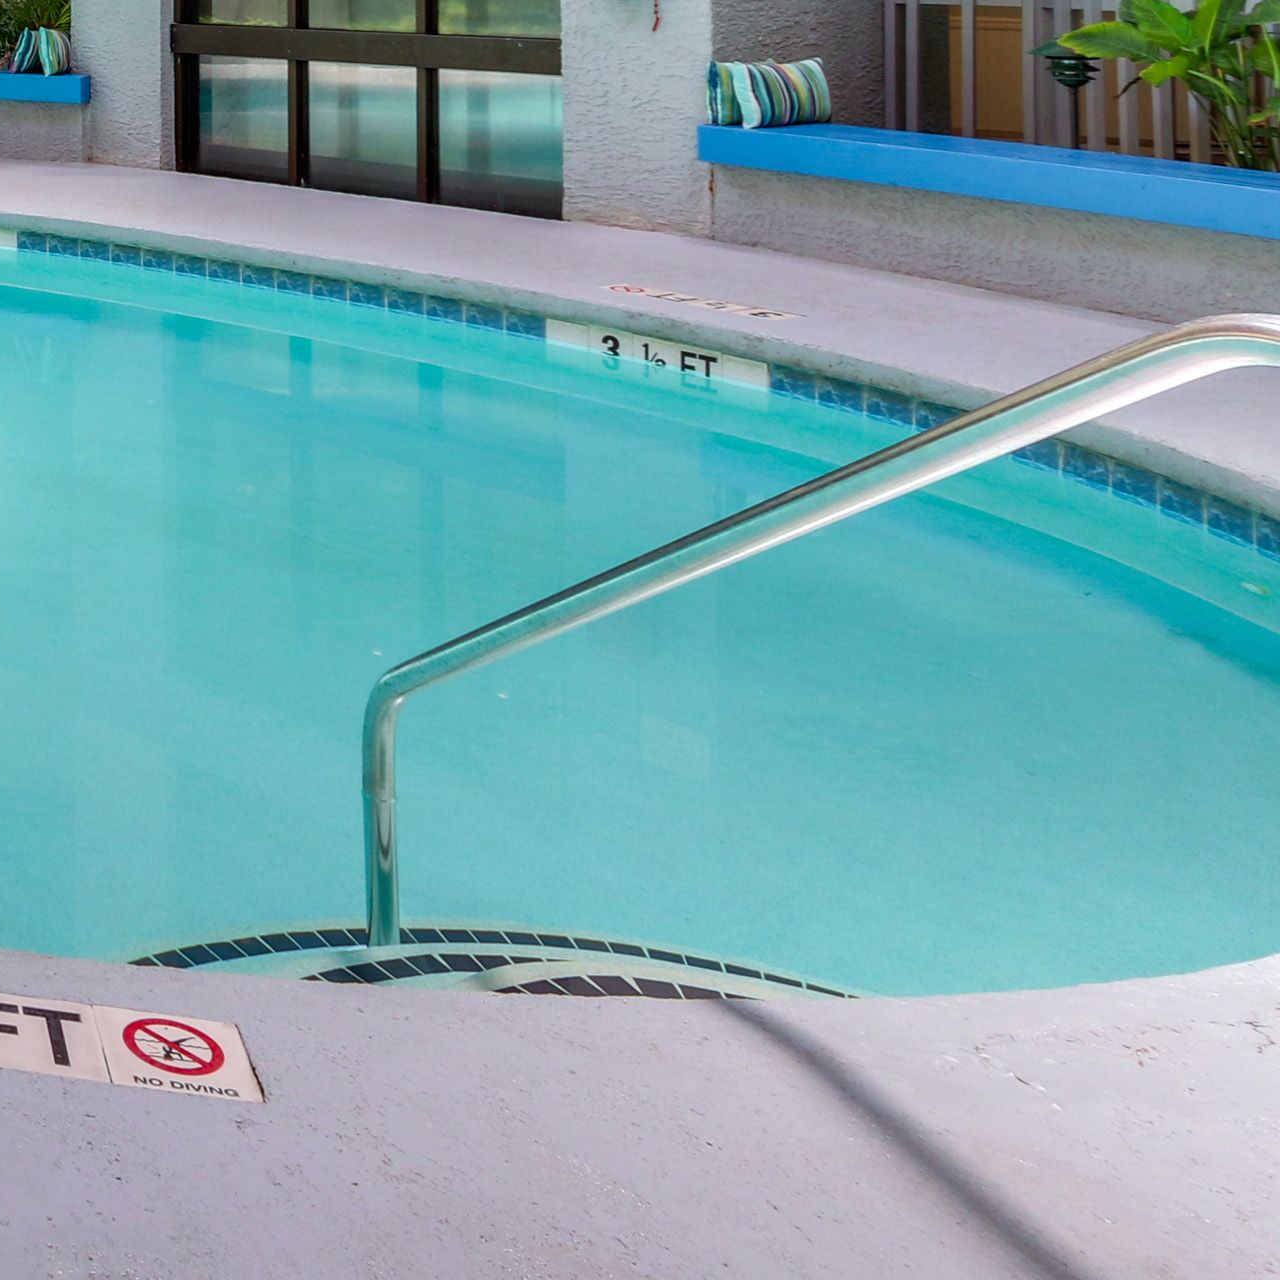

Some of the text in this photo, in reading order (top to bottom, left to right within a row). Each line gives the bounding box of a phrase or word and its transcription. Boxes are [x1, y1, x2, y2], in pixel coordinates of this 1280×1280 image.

[601, 335, 620, 357] 3
[680, 350, 718, 378] FT
[132, 1075, 241, 1098] NO DIVING
